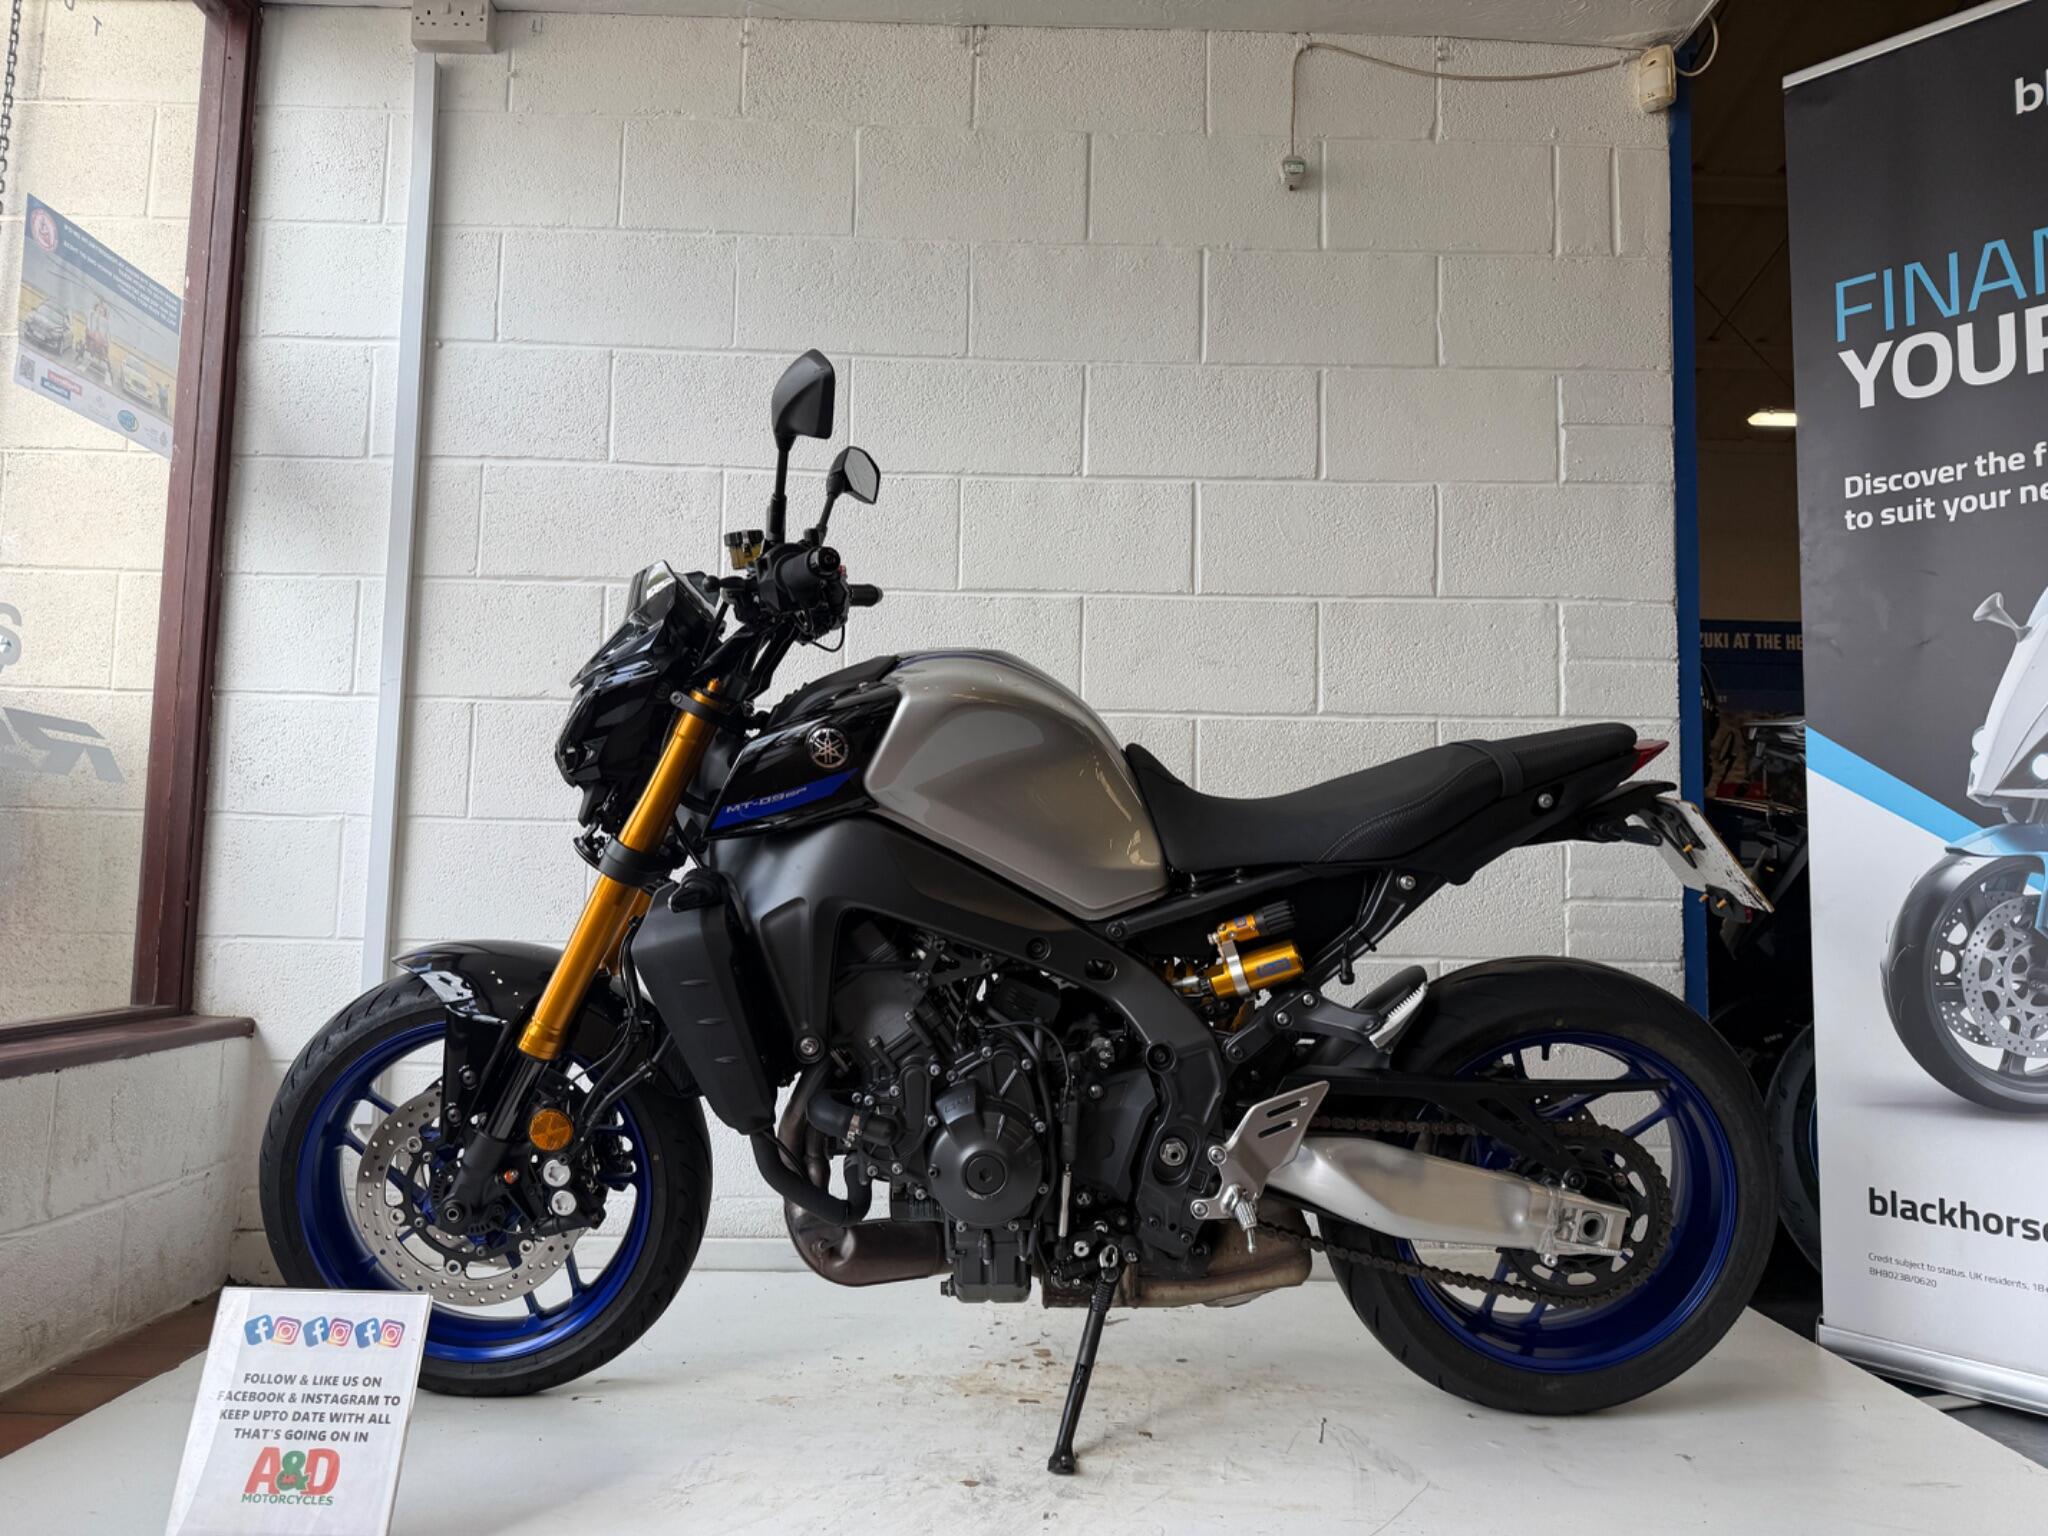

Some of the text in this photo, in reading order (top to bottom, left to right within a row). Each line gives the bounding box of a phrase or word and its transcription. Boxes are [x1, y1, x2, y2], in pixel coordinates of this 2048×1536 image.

[2014, 66, 2048, 115] b
[1845, 462, 1968, 499] Discover
[1974, 451, 2026, 477] the
[1844, 509, 1873, 530] to
[1880, 497, 1936, 525] suit
[1943, 488, 2011, 522] your
[1733, 633, 1750, 649] AT
[1755, 633, 1782, 650] THE
[1868, 1187, 2048, 1242] blackhors
[1868, 1252, 1893, 1265] Credit
[1894, 1256, 1925, 1270] subject
[1927, 1263, 1936, 1272] to
[1969, 1271, 1983, 1281] UK
[244, 1373, 382, 1388] FOLLOW & LIKE US ON
[217, 1391, 401, 1407] FACEBOOK & INSTAGRAM TO
[219, 1409, 392, 1425] KEEP UPTO DATE WITH ALL
[234, 1427, 369, 1443] THAT'S GOING ON IN
[244, 1446, 341, 1495] A&D
[241, 1493, 334, 1506] MOTORCYCLES
